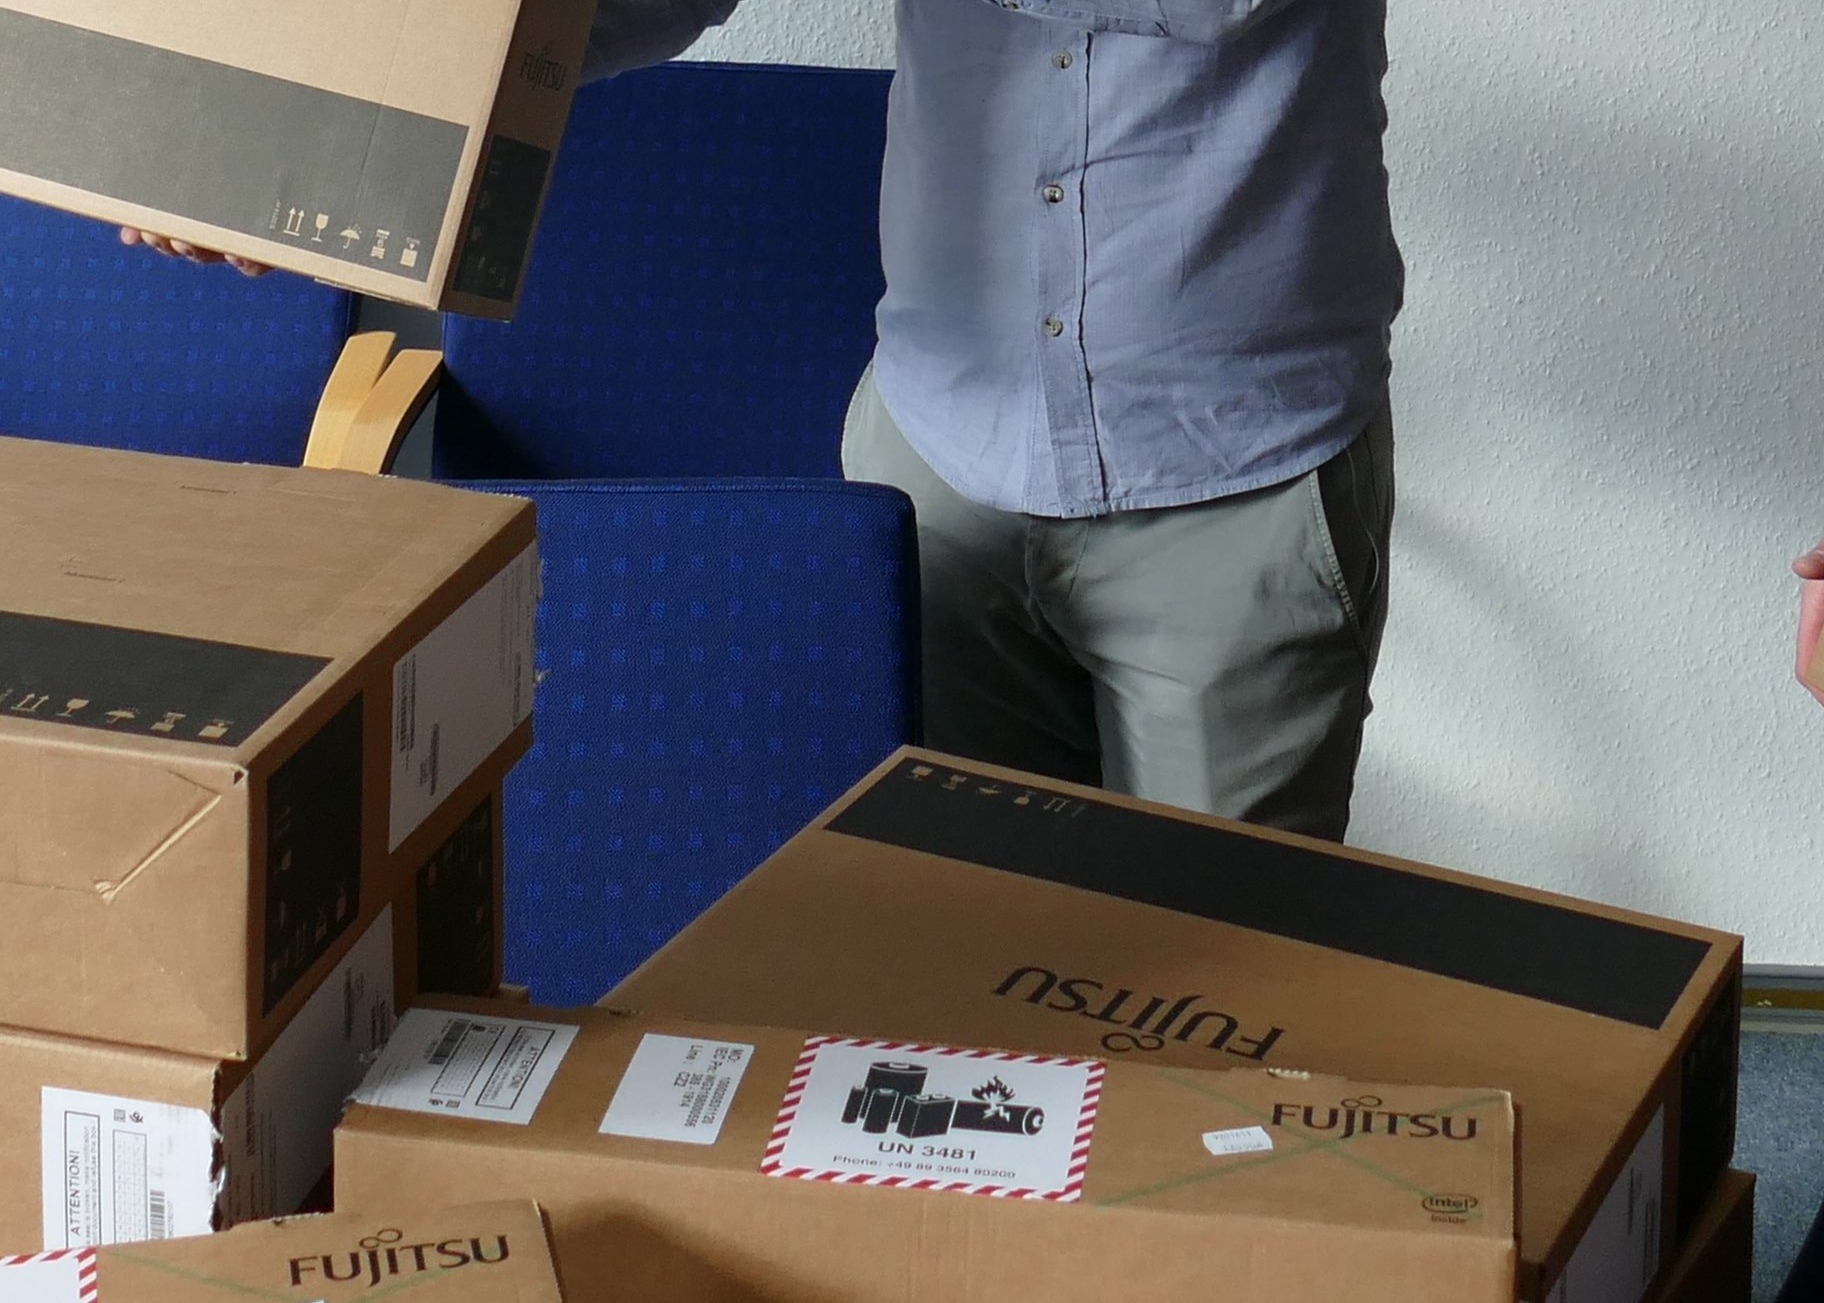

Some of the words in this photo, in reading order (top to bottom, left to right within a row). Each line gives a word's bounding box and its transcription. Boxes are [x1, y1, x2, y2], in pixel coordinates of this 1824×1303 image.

[991, 965, 1286, 1061] FUJITSU
[1271, 1095, 1478, 1141] FUJITSU
[832, 1154, 883, 1167] Phone:
[886, 1159, 912, 1170] +49
[916, 1162, 934, 1172] 89
[936, 1163, 970, 1176] 3564
[974, 1166, 1016, 1179] 80200
[878, 1141, 915, 1154] UN
[921, 1145, 977, 1161] 3481
[68, 1149, 81, 1236] ATTENTION!
[289, 1227, 511, 1288] FUJITSU
